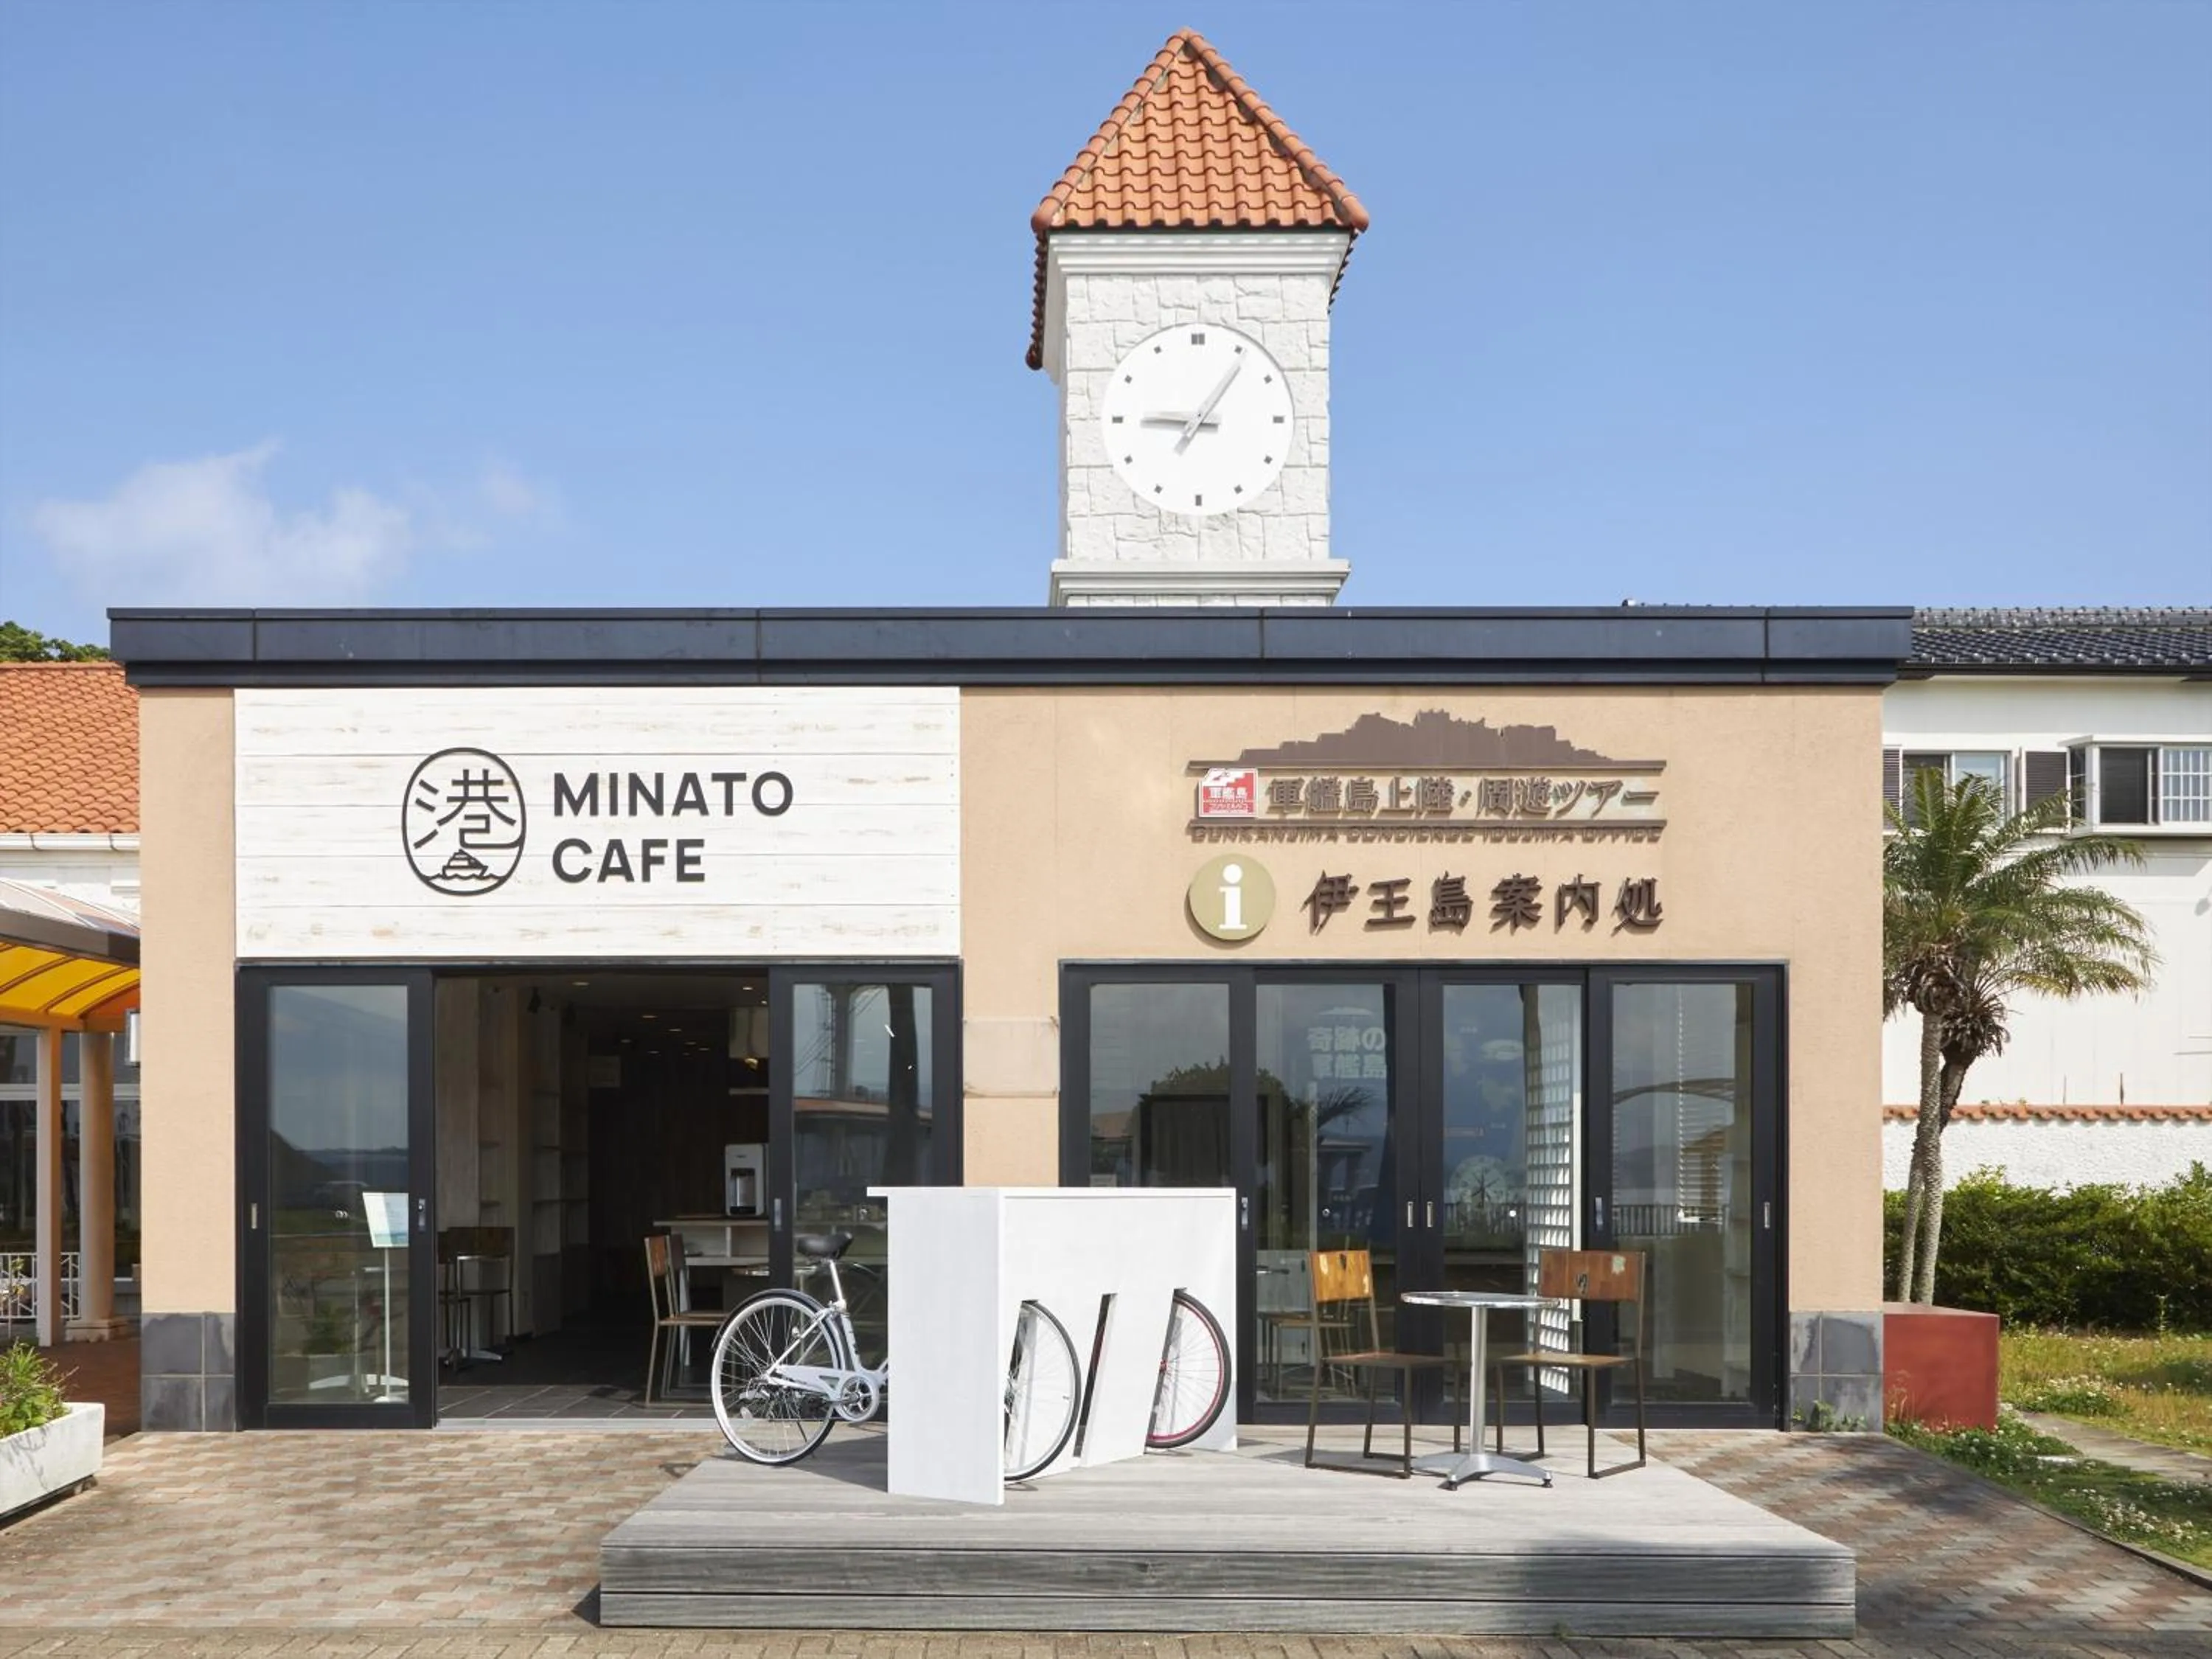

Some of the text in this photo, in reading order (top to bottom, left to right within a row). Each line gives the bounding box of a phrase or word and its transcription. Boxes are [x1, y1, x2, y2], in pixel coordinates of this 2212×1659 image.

[414, 768, 521, 849] 港
[554, 771, 794, 817] MINATO
[552, 838, 706, 883] CAFE
[1304, 870, 1663, 934] 伊王島案内処
